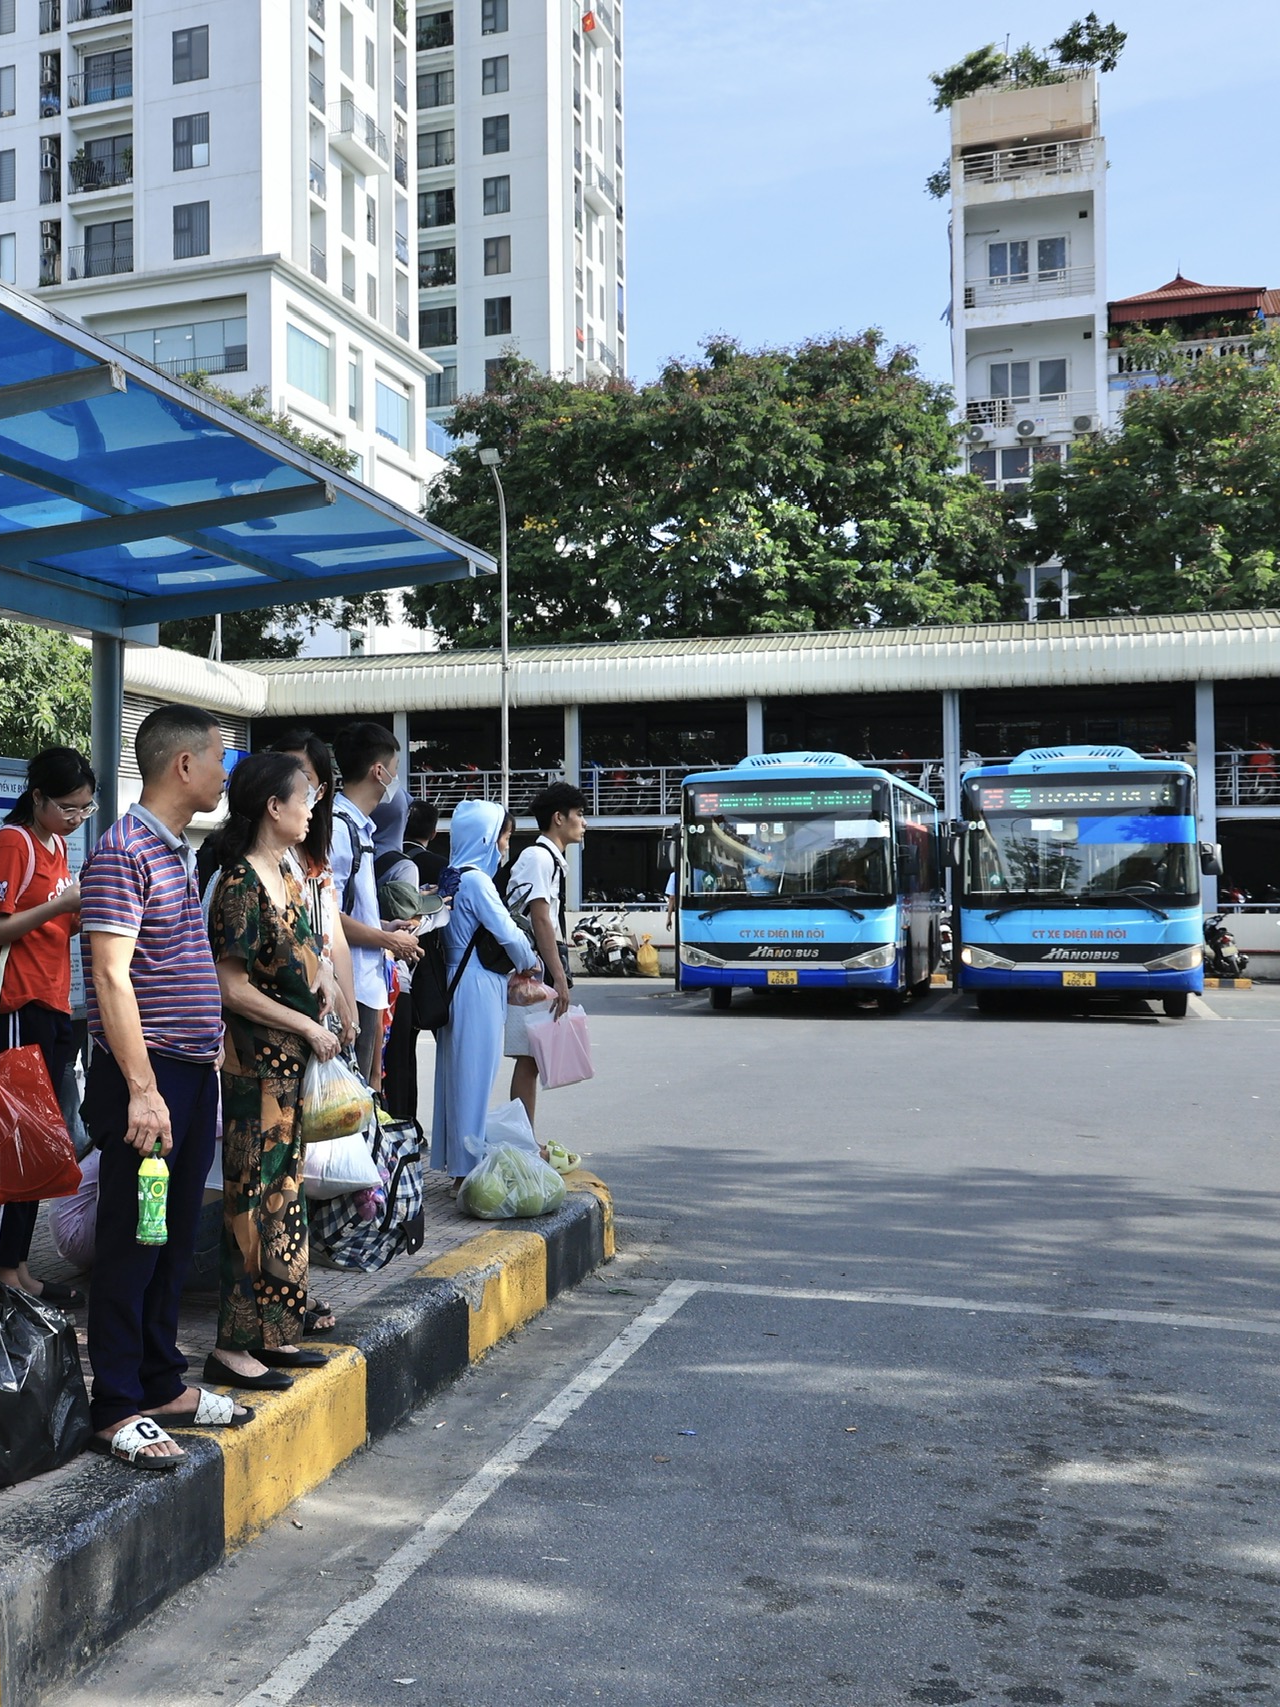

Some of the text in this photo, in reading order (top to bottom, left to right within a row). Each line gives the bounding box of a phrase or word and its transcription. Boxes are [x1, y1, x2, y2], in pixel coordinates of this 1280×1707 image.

[10, 785, 17, 793] XE
[739, 928, 825, 941] CT XE ĐIỆN HÀ NỘI
[1032, 928, 1127, 941] CT XE ĐIỆN HÀ NỘI
[1041, 948, 1120, 960] HANOIBUS
